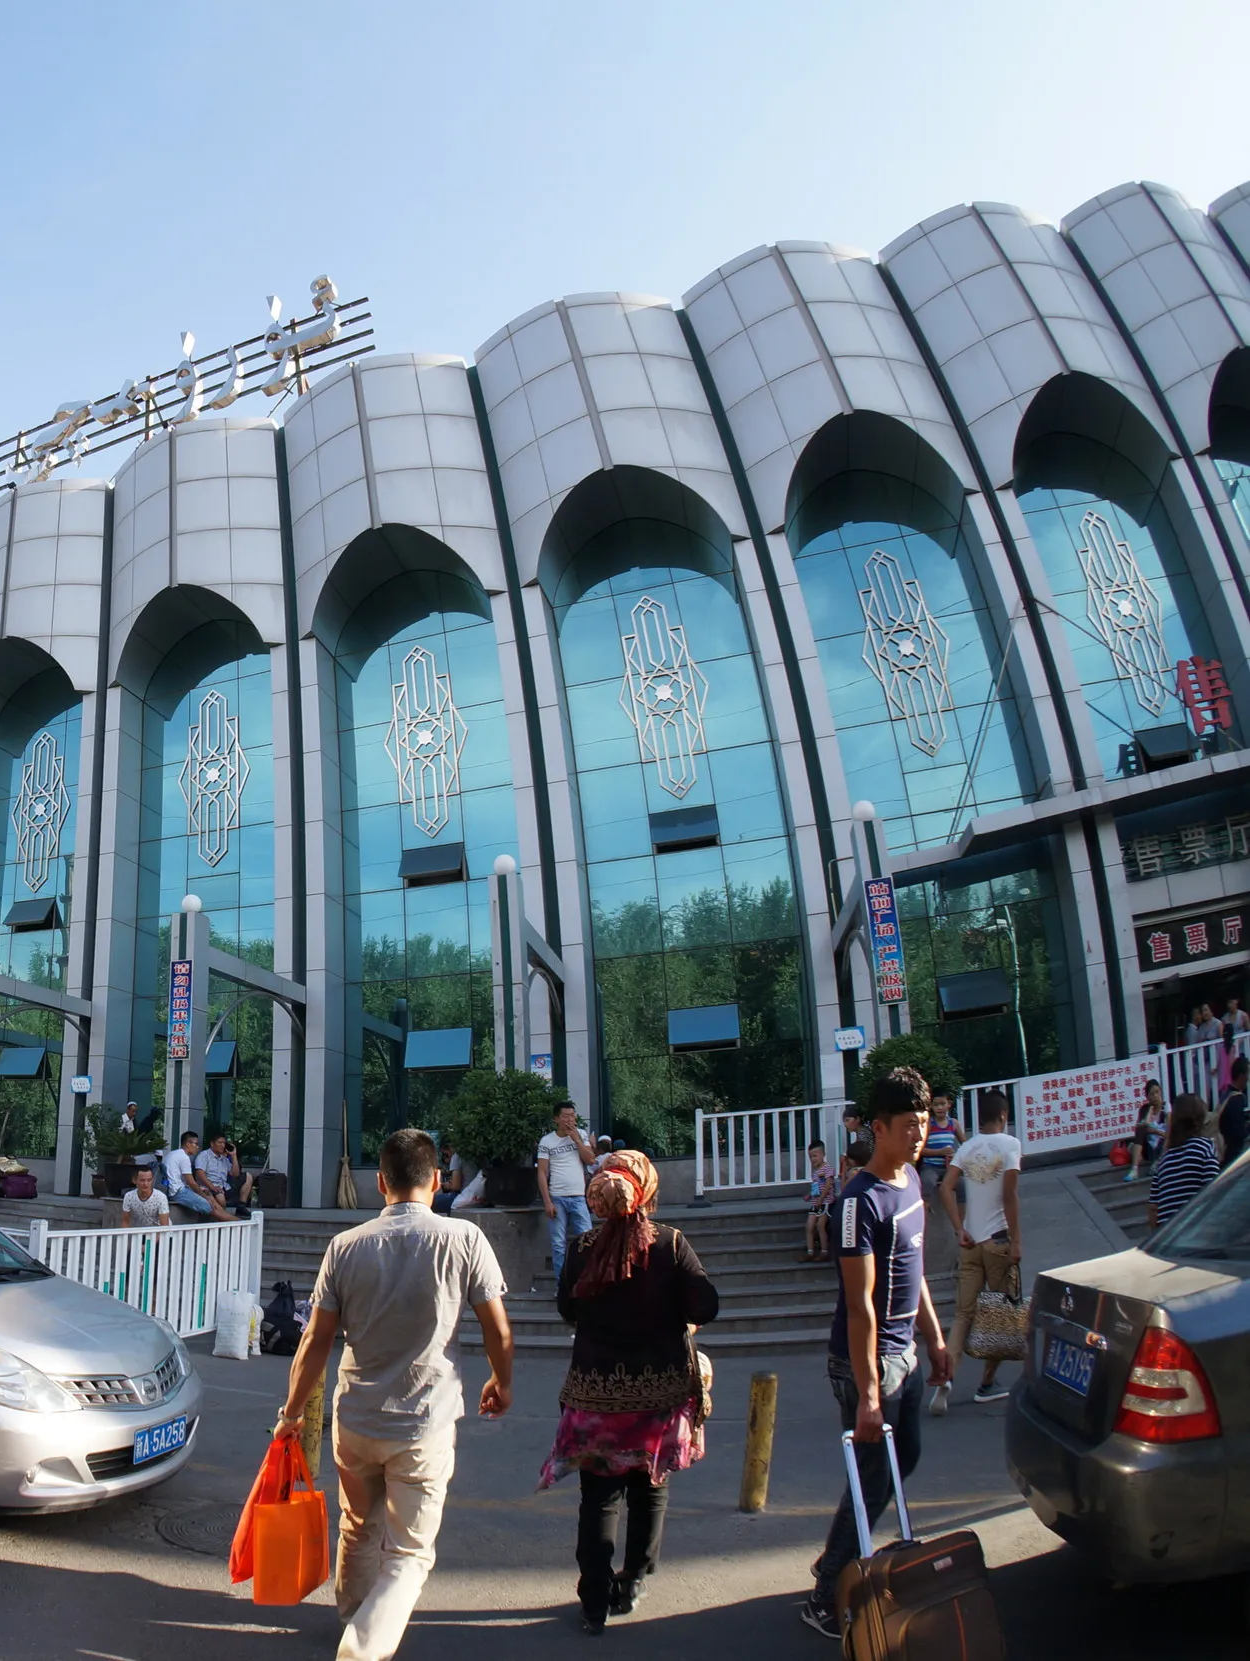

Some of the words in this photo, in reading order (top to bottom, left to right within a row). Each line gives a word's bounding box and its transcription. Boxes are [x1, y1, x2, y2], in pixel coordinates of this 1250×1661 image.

[1175, 656, 1233, 735] 售
[1133, 817, 1250, 876] 售票厅
[867, 882, 896, 937] 站前广场
[1147, 915, 1242, 962] 售票厅
[877, 945, 903, 1000] 严禁吸烟
[170, 962, 190, 1058] 请勿乱扔果皮纸屑
